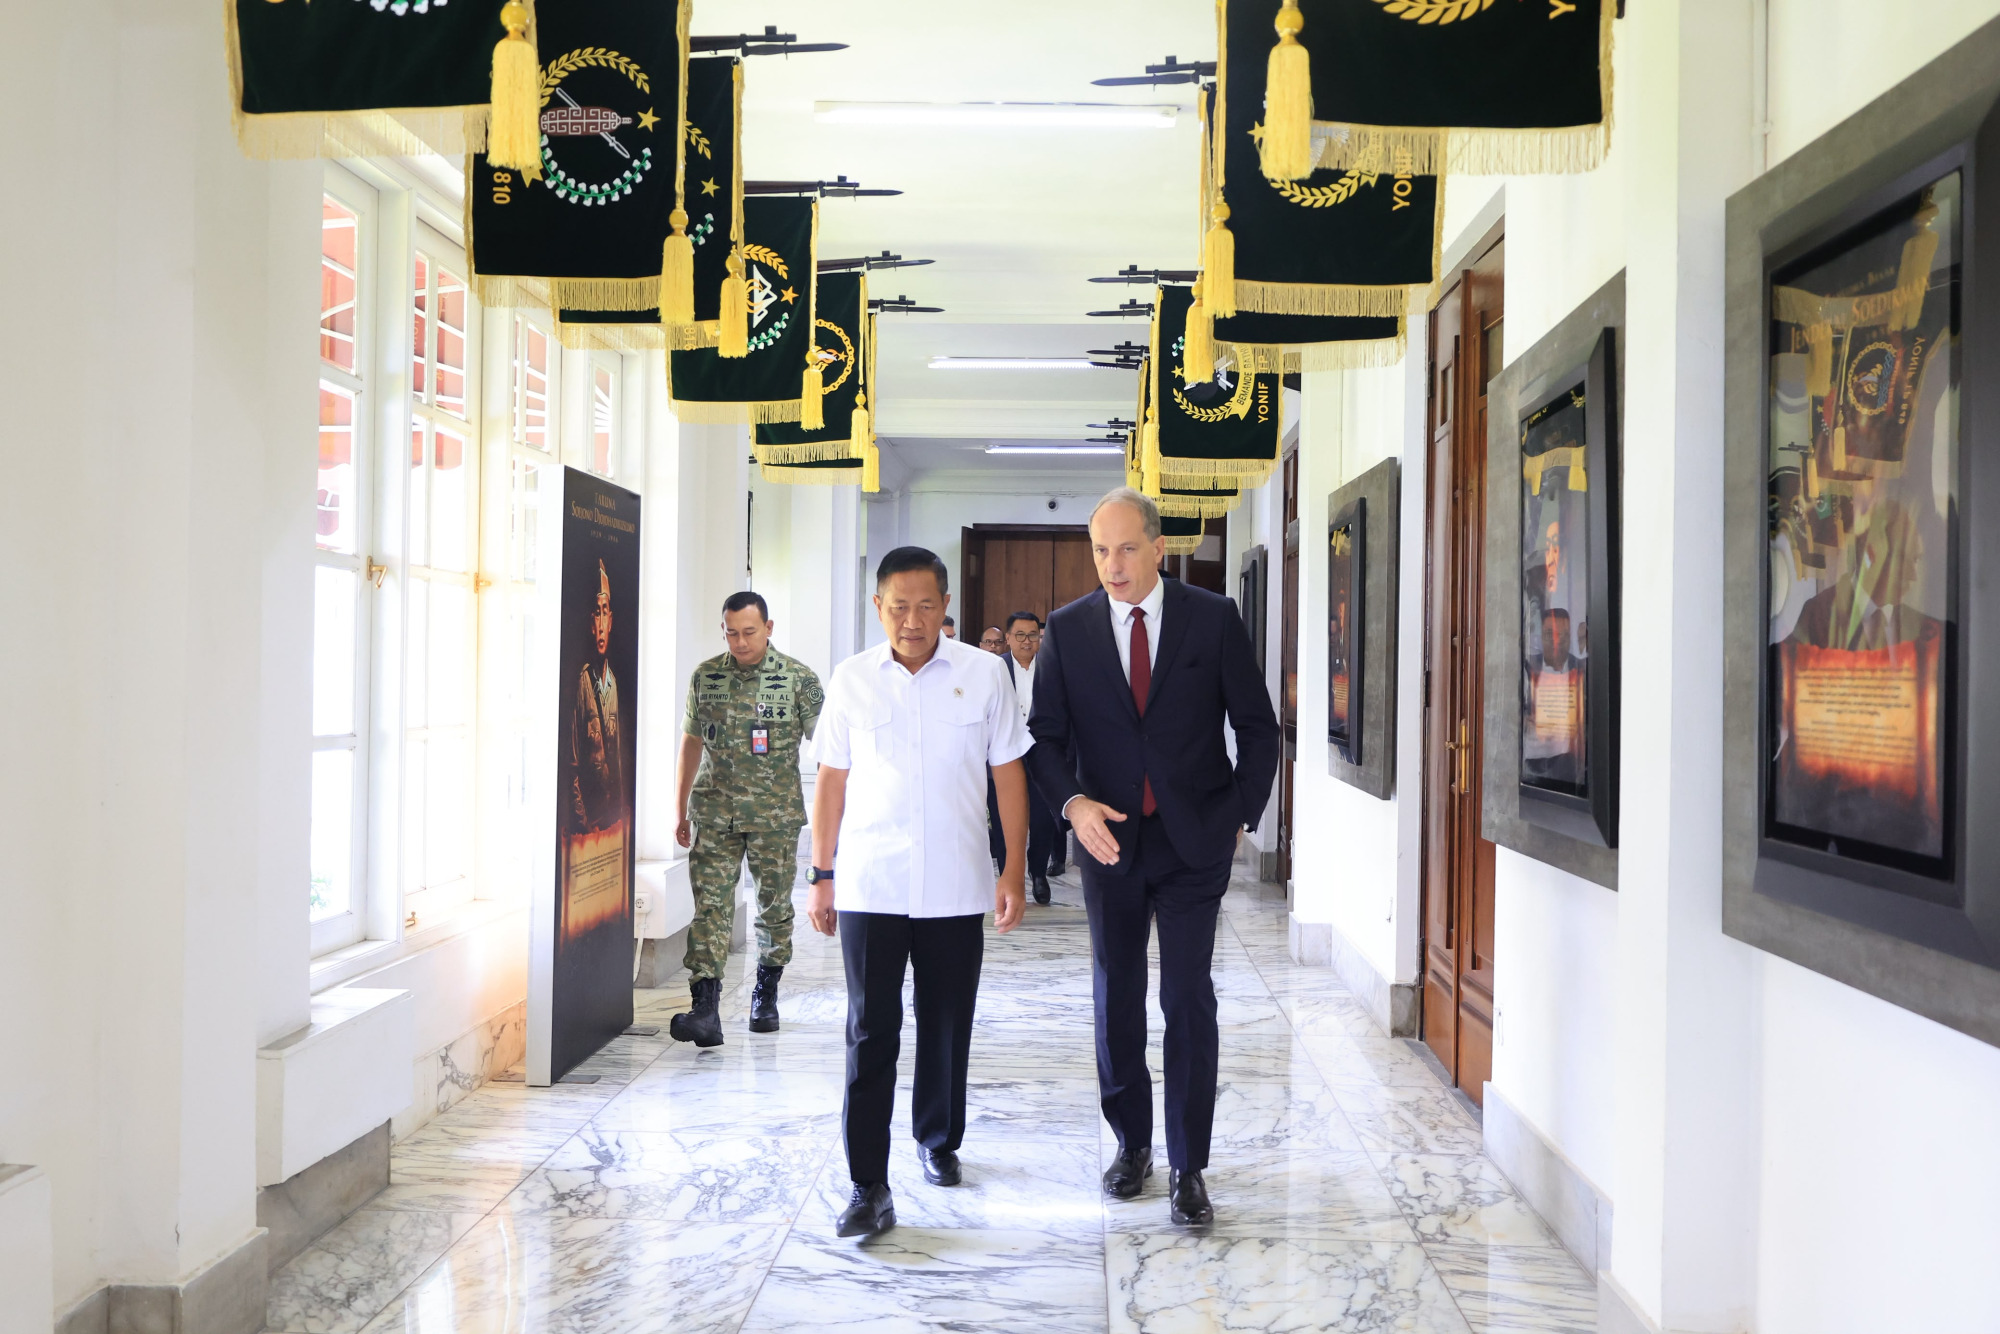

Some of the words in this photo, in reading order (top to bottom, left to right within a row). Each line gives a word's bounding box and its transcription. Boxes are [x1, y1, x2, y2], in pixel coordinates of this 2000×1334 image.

[492, 171, 512, 205] 810
[1236, 371, 1253, 406] BEMANDE
[1258, 381, 1269, 424] YONIF
[761, 693, 775, 701] TNI
[779, 693, 791, 701] AL
